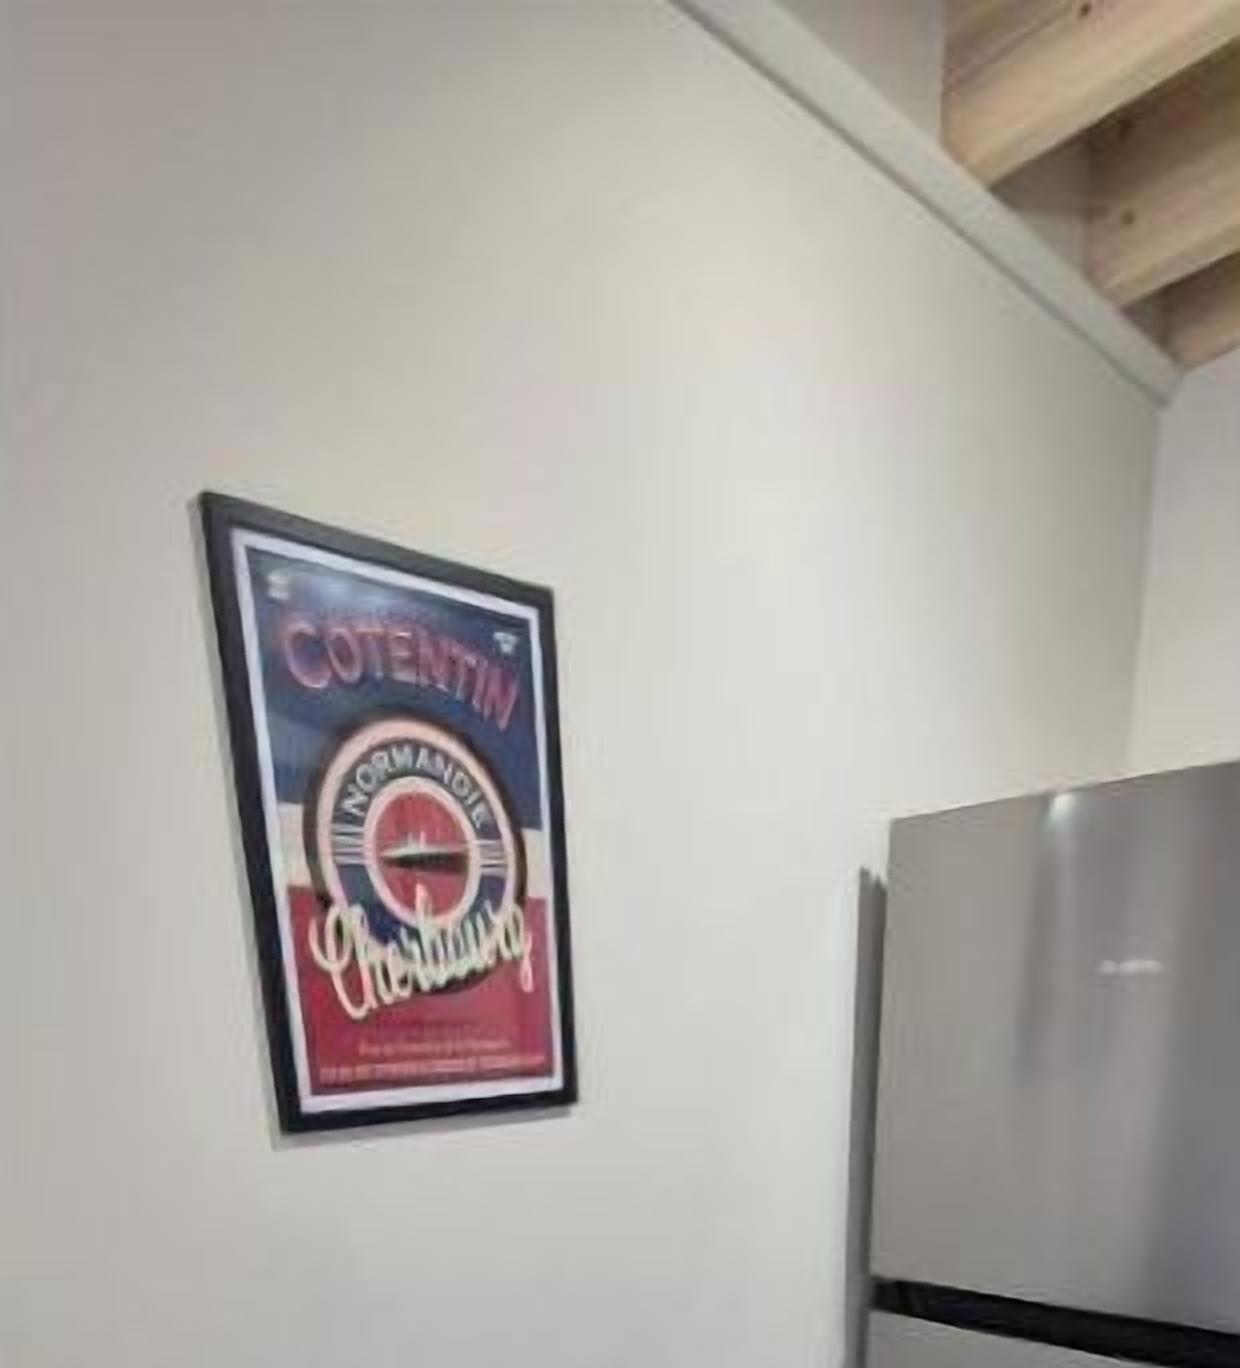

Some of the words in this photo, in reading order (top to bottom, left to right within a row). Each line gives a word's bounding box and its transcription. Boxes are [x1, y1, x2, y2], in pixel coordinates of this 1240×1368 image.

[283, 616, 519, 730] COTENTIN
[341, 745, 487, 829] NORMANDIE
[308, 883, 534, 1019] Cherbourg
